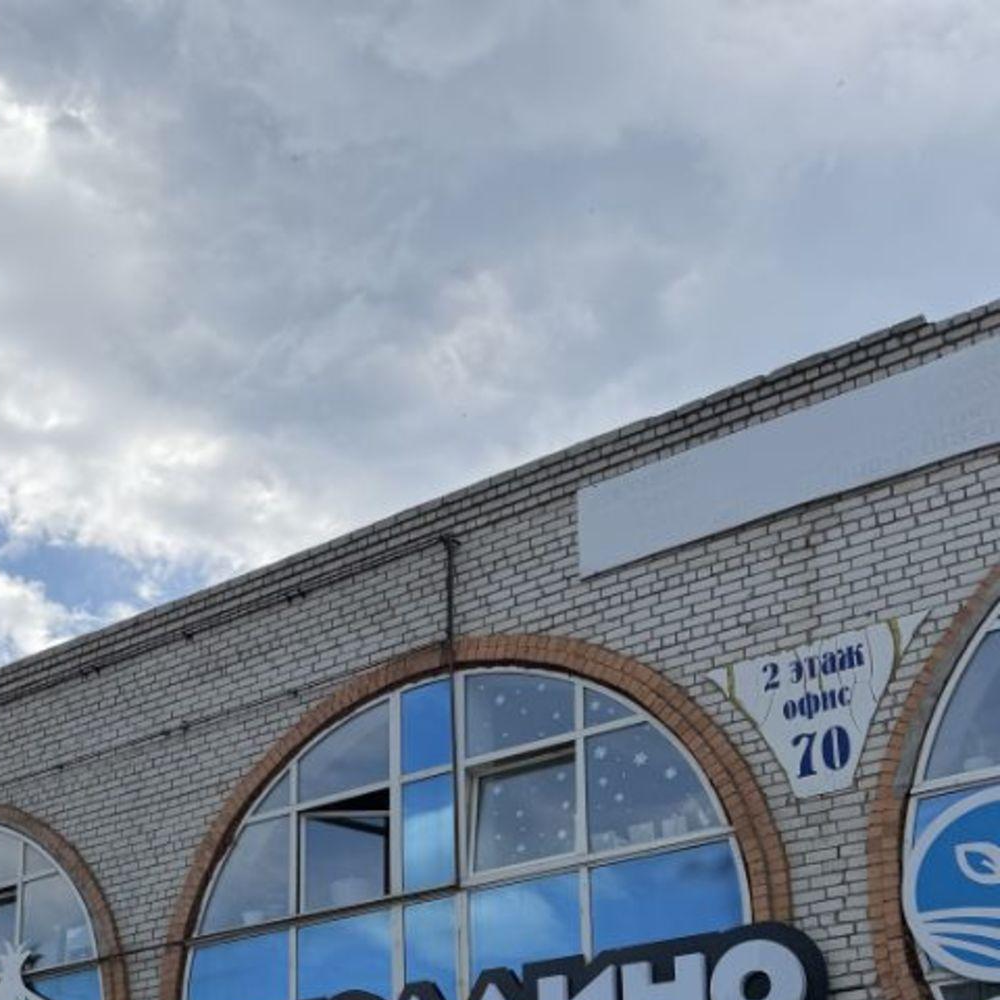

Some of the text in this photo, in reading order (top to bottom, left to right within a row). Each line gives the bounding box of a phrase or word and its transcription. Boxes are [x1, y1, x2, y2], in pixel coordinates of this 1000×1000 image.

[761, 643, 867, 693] 2 этаж
[782, 685, 851, 722] офис
[791, 725, 851, 780] 70
